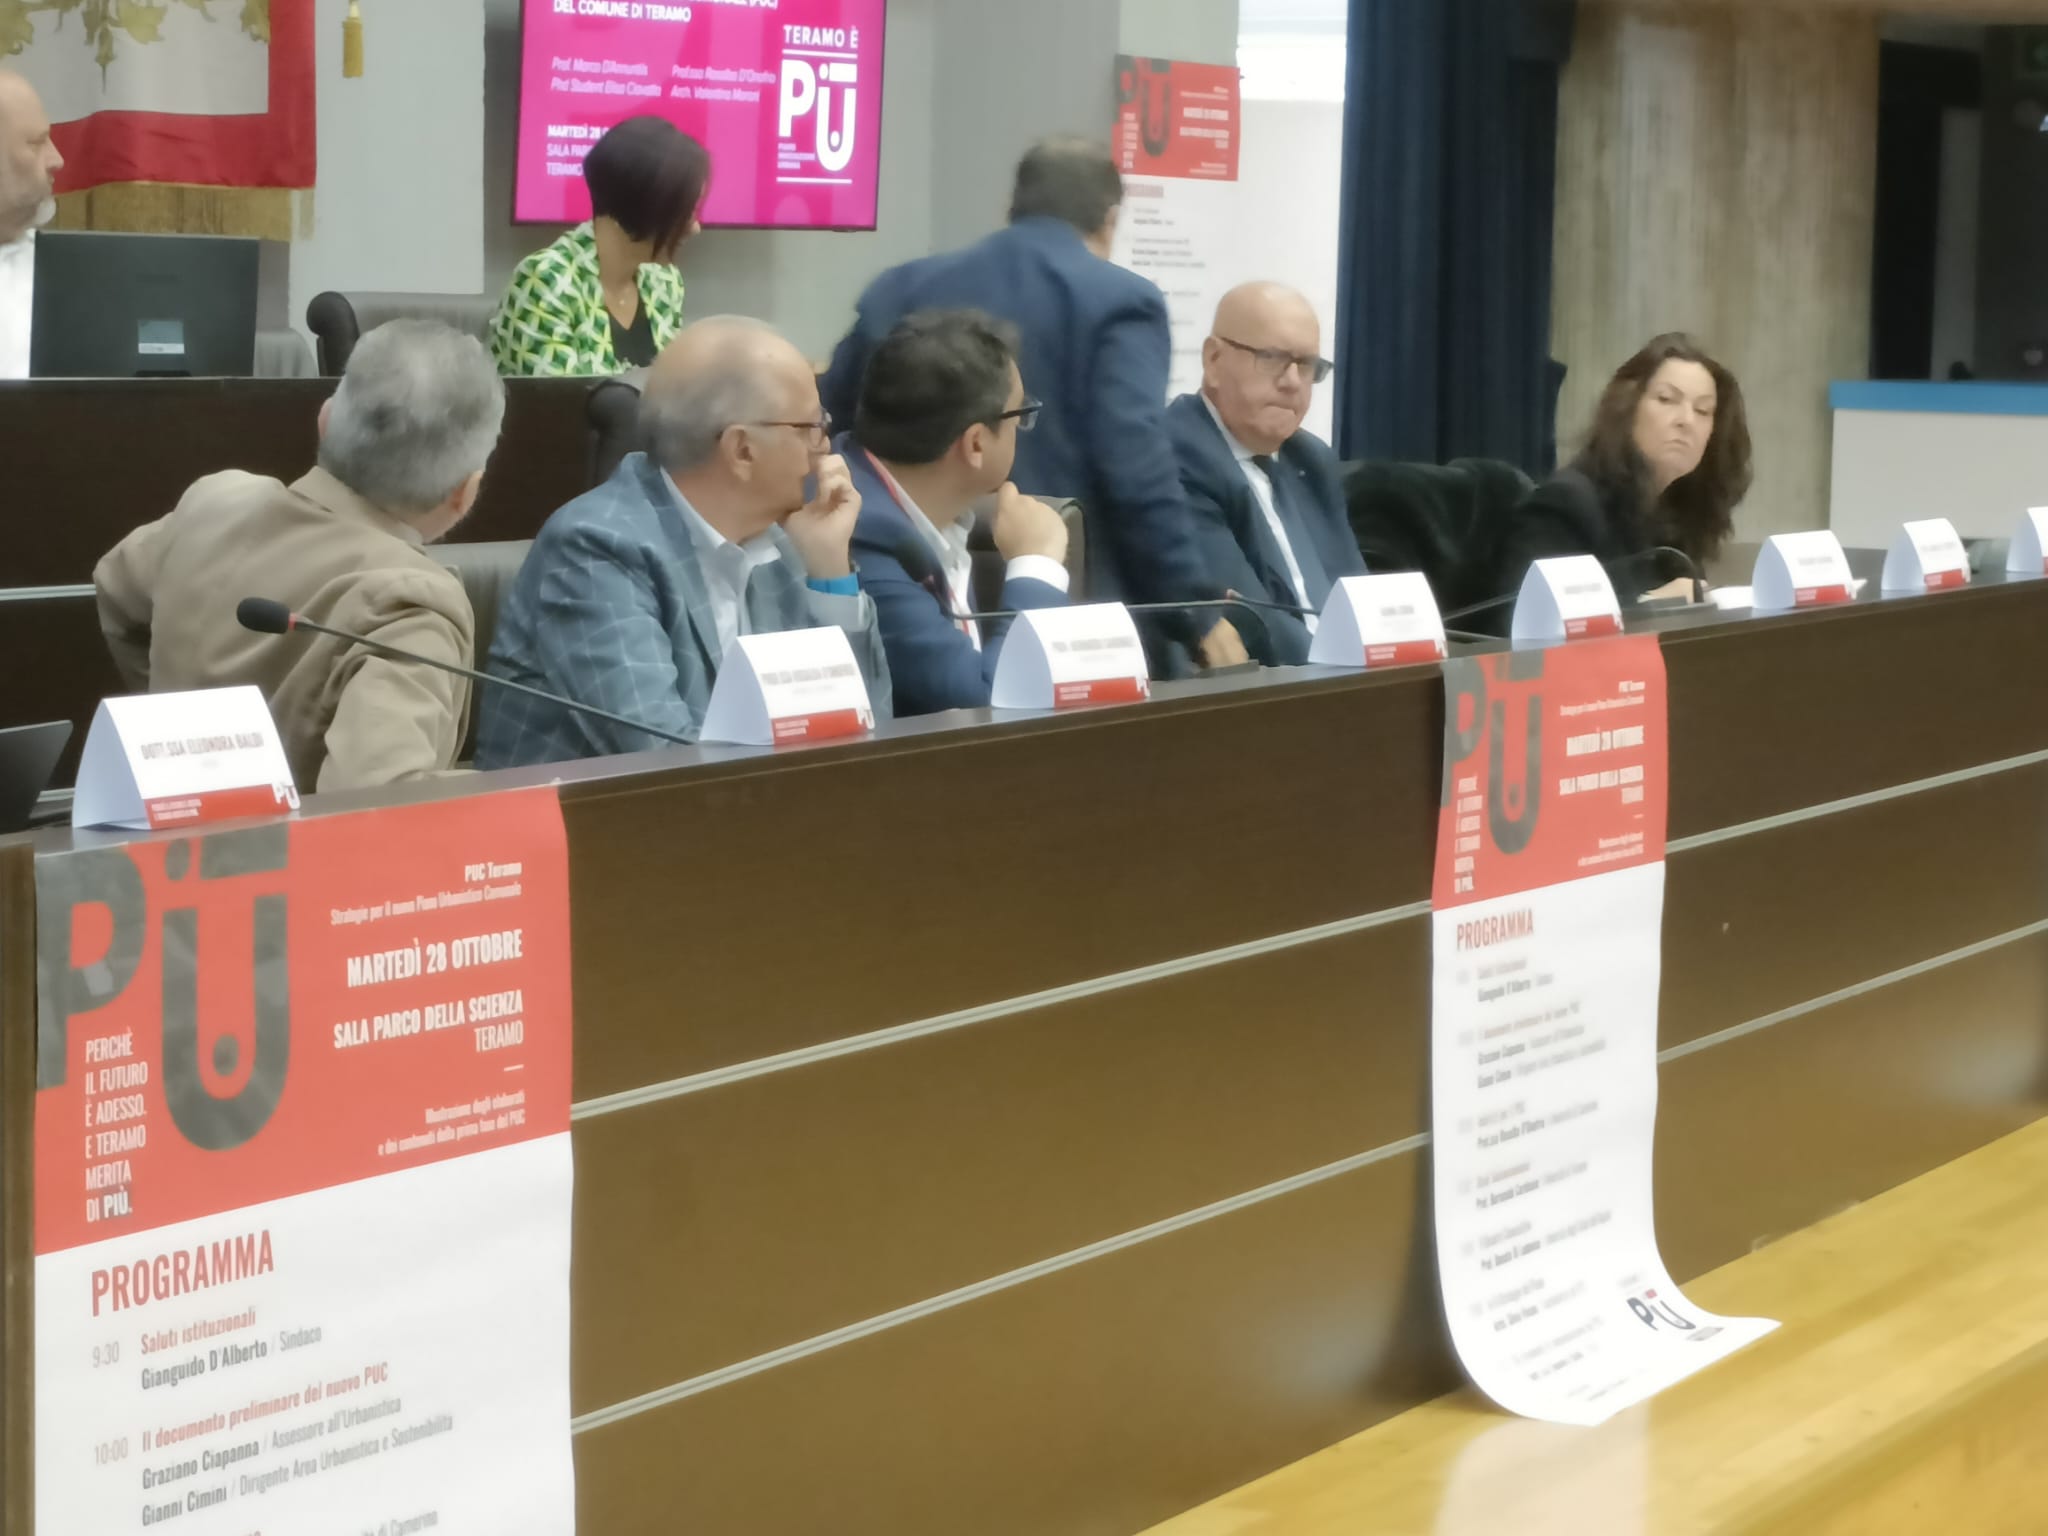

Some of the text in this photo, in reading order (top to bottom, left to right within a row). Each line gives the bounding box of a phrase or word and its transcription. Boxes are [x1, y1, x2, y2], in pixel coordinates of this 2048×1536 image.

[553, 0, 692, 22] DEL COMUNE DI TERAMO
[783, 24, 858, 48] TERAMO È
[465, 863, 486, 882] PUC
[1457, 908, 1534, 951] PROGRAMMA
[347, 928, 522, 987] MARTEDÌ 28 OTTOBRE
[334, 989, 523, 1049] SALA PARCO DELLA SCIENZA
[474, 1020, 524, 1052] TERAMO
[86, 1061, 148, 1095] IL FUTURO
[96, 1124, 146, 1156] TERAMO
[86, 1160, 132, 1190] MERITA
[87, 1199, 99, 1222] DI
[92, 1229, 274, 1317] PROGRAMMA
[141, 1328, 178, 1355] Saluti
[182, 1306, 256, 1344] istituzionali
[142, 1326, 322, 1390] Gianguido D'Alberto Sindaco
[143, 1431, 151, 1451] Il
[156, 1413, 225, 1448] documento
[229, 1392, 300, 1430] preliminare
[304, 1380, 322, 1404] del
[326, 1375, 360, 1397] nuovo
[364, 1361, 388, 1385] PUC
[143, 1398, 401, 1489] Graziano Ciapanna Assessore all'Urbanistica
[142, 1499, 182, 1526] Gianni
[187, 1486, 227, 1512] Cimini
[240, 1465, 289, 1496] Dirigente
[293, 1457, 317, 1478] Area
[321, 1438, 379, 1470] Urbanistica
